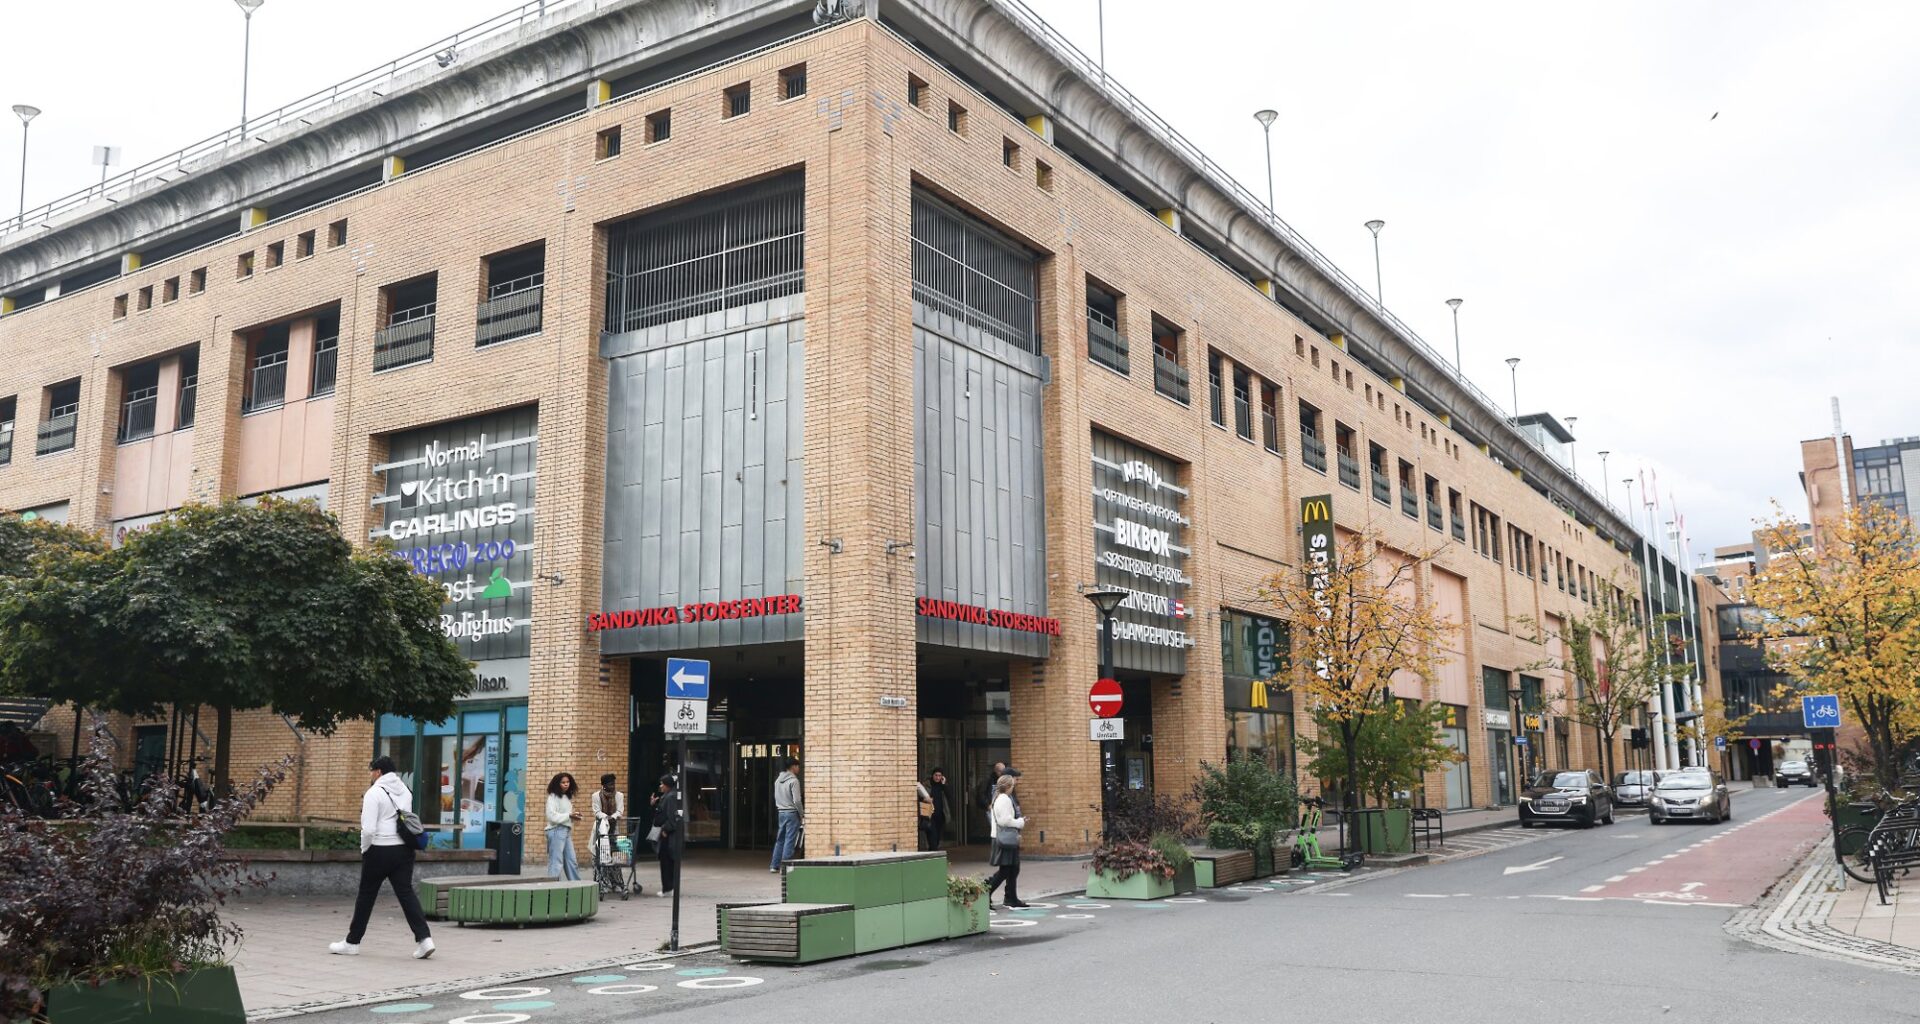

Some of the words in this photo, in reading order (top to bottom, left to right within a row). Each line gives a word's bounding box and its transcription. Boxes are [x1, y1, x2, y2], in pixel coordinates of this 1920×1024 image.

[425, 433, 487, 469] Normal
[1121, 460, 1162, 491] MENY
[389, 502, 517, 541] CARLINGS
[1104, 488, 1143, 511] OPTIKER
[1153, 504, 1181, 523] KROGH
[474, 539, 516, 563] ZOO
[1114, 517, 1171, 558] BIKBOK
[1105, 551, 1153, 577] SØSTRENE
[1152, 563, 1183, 585] GRENE
[440, 609, 513, 642] Bolighus
[587, 606, 678, 632] SANDVIKA
[684, 594, 801, 623] STORSENTER
[918, 596, 987, 625] SANDVIKA
[990, 608, 1061, 637] STORSENTER
[1121, 620, 1186, 649] LAMPEHUSET
[673, 721, 699, 730] Unntatt
